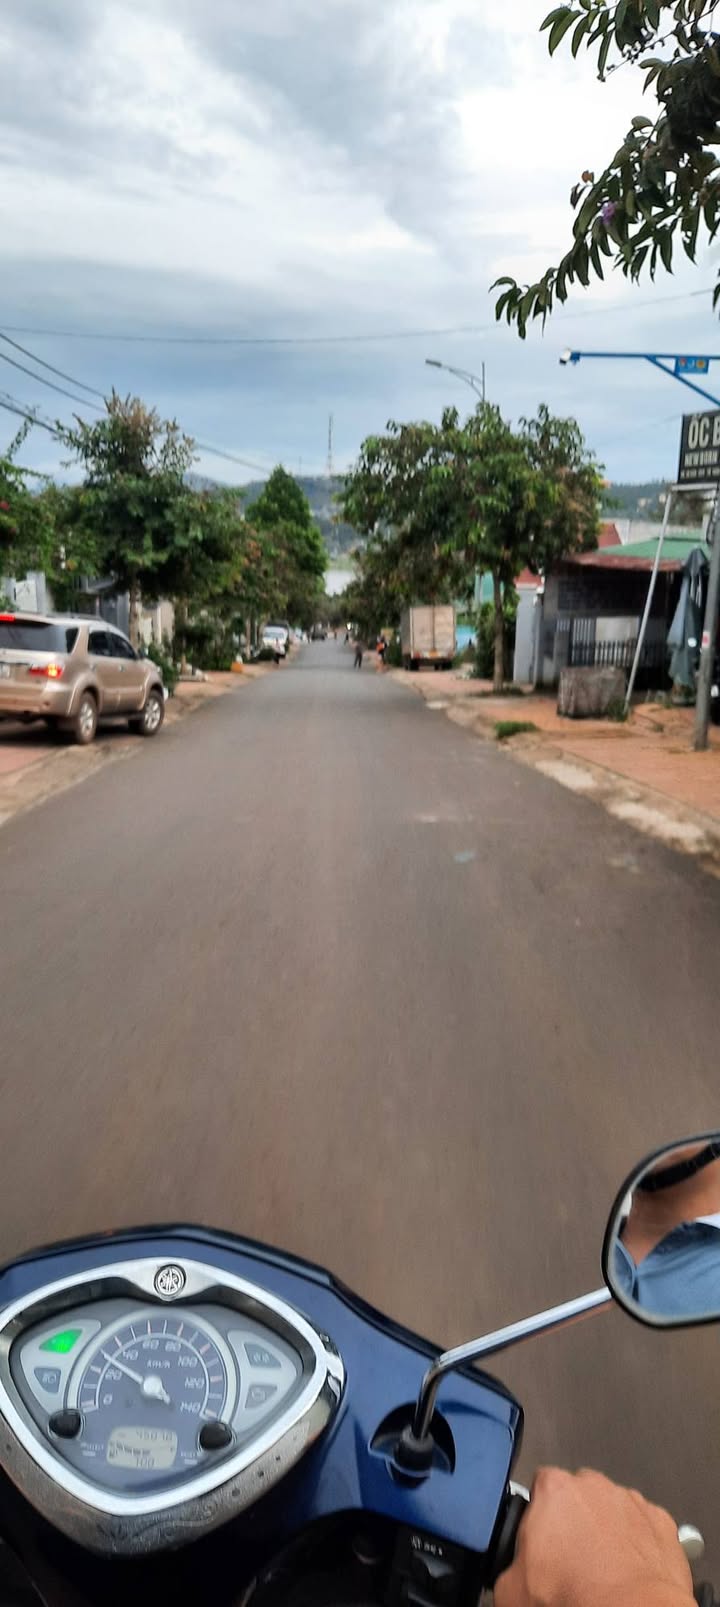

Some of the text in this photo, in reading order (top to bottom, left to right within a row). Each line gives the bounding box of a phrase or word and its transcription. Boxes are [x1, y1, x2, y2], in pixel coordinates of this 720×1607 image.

[142, 1339, 181, 1352] 60 80
[122, 1349, 139, 1360] 40
[178, 1356, 198, 1367] 100
[105, 1369, 122, 1380] 20
[184, 1378, 204, 1389] 120
[103, 1393, 112, 1405] 0
[180, 1402, 201, 1412] 140
